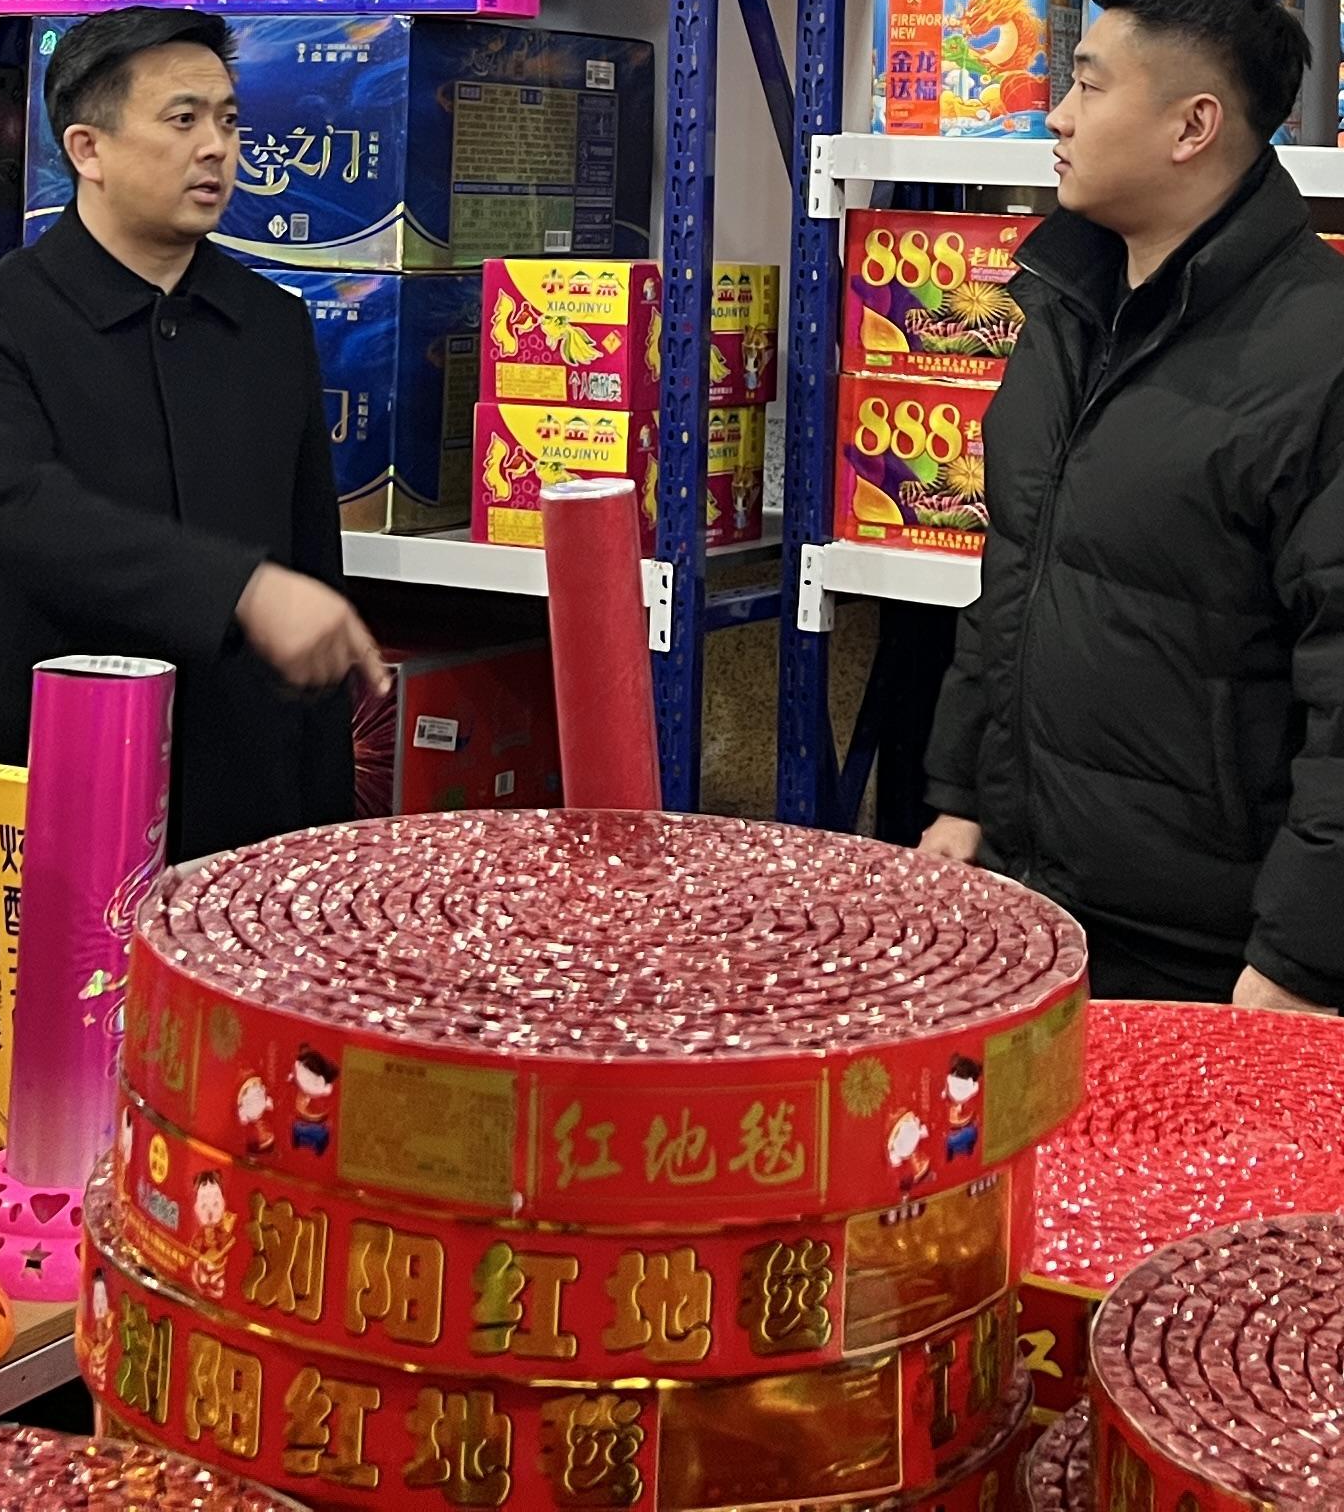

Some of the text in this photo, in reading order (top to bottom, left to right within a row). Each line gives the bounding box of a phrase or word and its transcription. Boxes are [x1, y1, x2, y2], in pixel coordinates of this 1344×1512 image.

[891, 27, 916, 39] NEW
[862, 228, 966, 289] 888
[541, 268, 624, 297] 小金鱼
[546, 300, 612, 314] XIAOJINYU
[536, 414, 623, 444] 小金鱼
[855, 397, 962, 463] 888
[542, 445, 609, 461] XIAOJINYU
[552, 1099, 805, 1187] 红地毯
[246, 1193, 833, 1362] 浏阳红地毯
[114, 1292, 646, 1509] 浏阳红地毯
